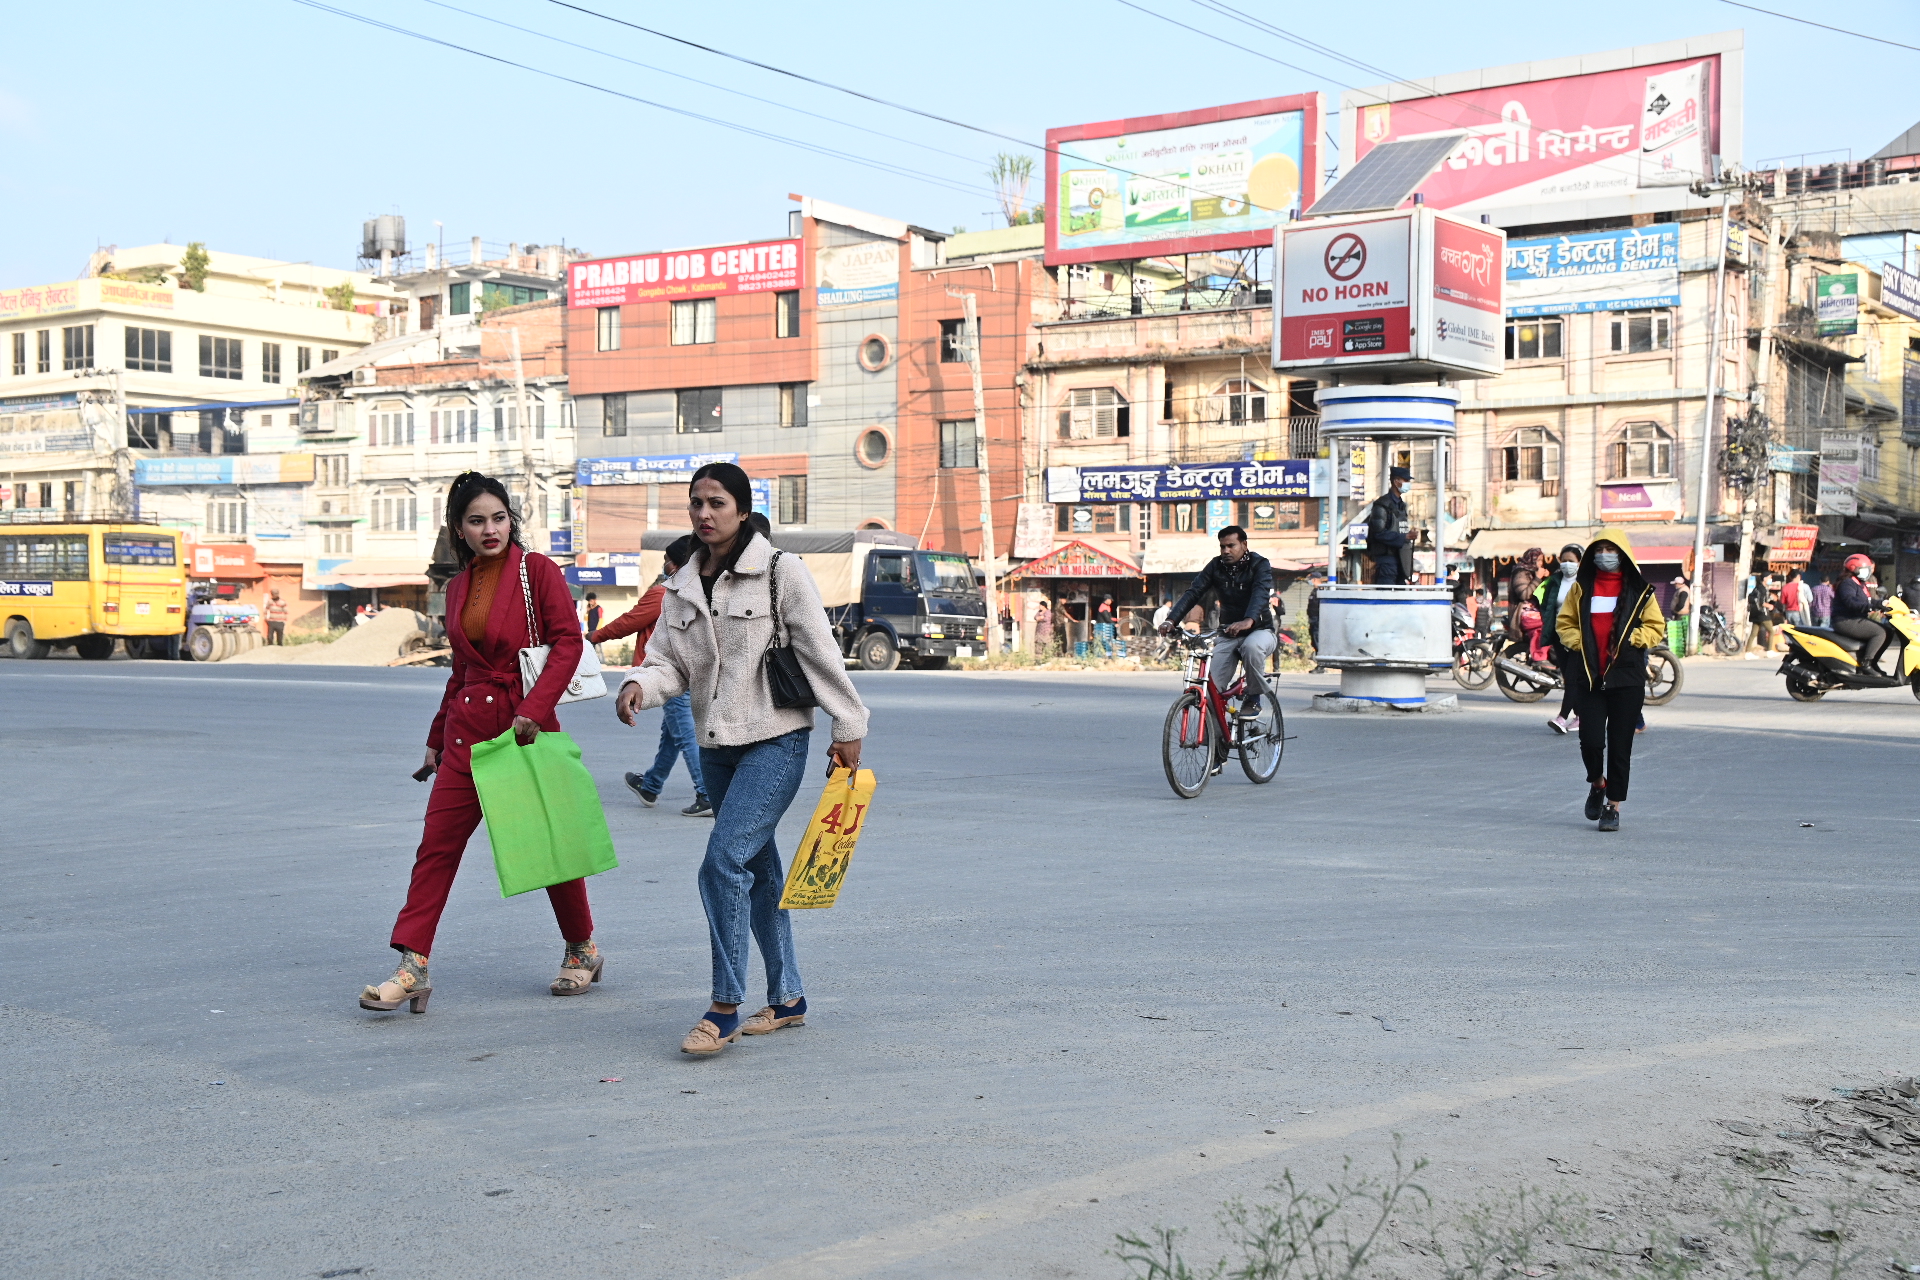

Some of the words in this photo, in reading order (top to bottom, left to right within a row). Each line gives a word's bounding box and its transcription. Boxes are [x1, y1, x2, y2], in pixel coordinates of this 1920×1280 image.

[1538, 124, 1635, 160] सिमेन्ट
[1197, 161, 1244, 176] OKHATI
[1621, 229, 1662, 262] होम
[573, 257, 660, 290] PRABHU
[664, 253, 706, 281] JOB
[710, 243, 797, 277] CENTER
[842, 248, 895, 268] JAPAN
[1440, 246, 1462, 268] बचत
[1549, 262, 1618, 278] LAMJUNG
[1620, 257, 1678, 272] DENTAL
[1883, 264, 1900, 291] SKY
[638, 284, 666, 298] Gongabu
[691, 280, 727, 292] Kathmandu
[818, 289, 864, 305] SHAILUNG
[1302, 287, 1328, 303] NO
[1335, 281, 1389, 300] HORN
[1309, 335, 1332, 349] pay
[1447, 322, 1466, 336] Global
[1467, 326, 1480, 339] IME
[1481, 330, 1495, 342] Bank
[1354, 342, 1367, 350] App
[1367, 340, 1382, 348] Store
[1166, 463, 1234, 488] डेन्टल
[1240, 461, 1285, 486] होम
[1618, 492, 1642, 502] Ncell
[23, 582, 52, 597] स्कूल
